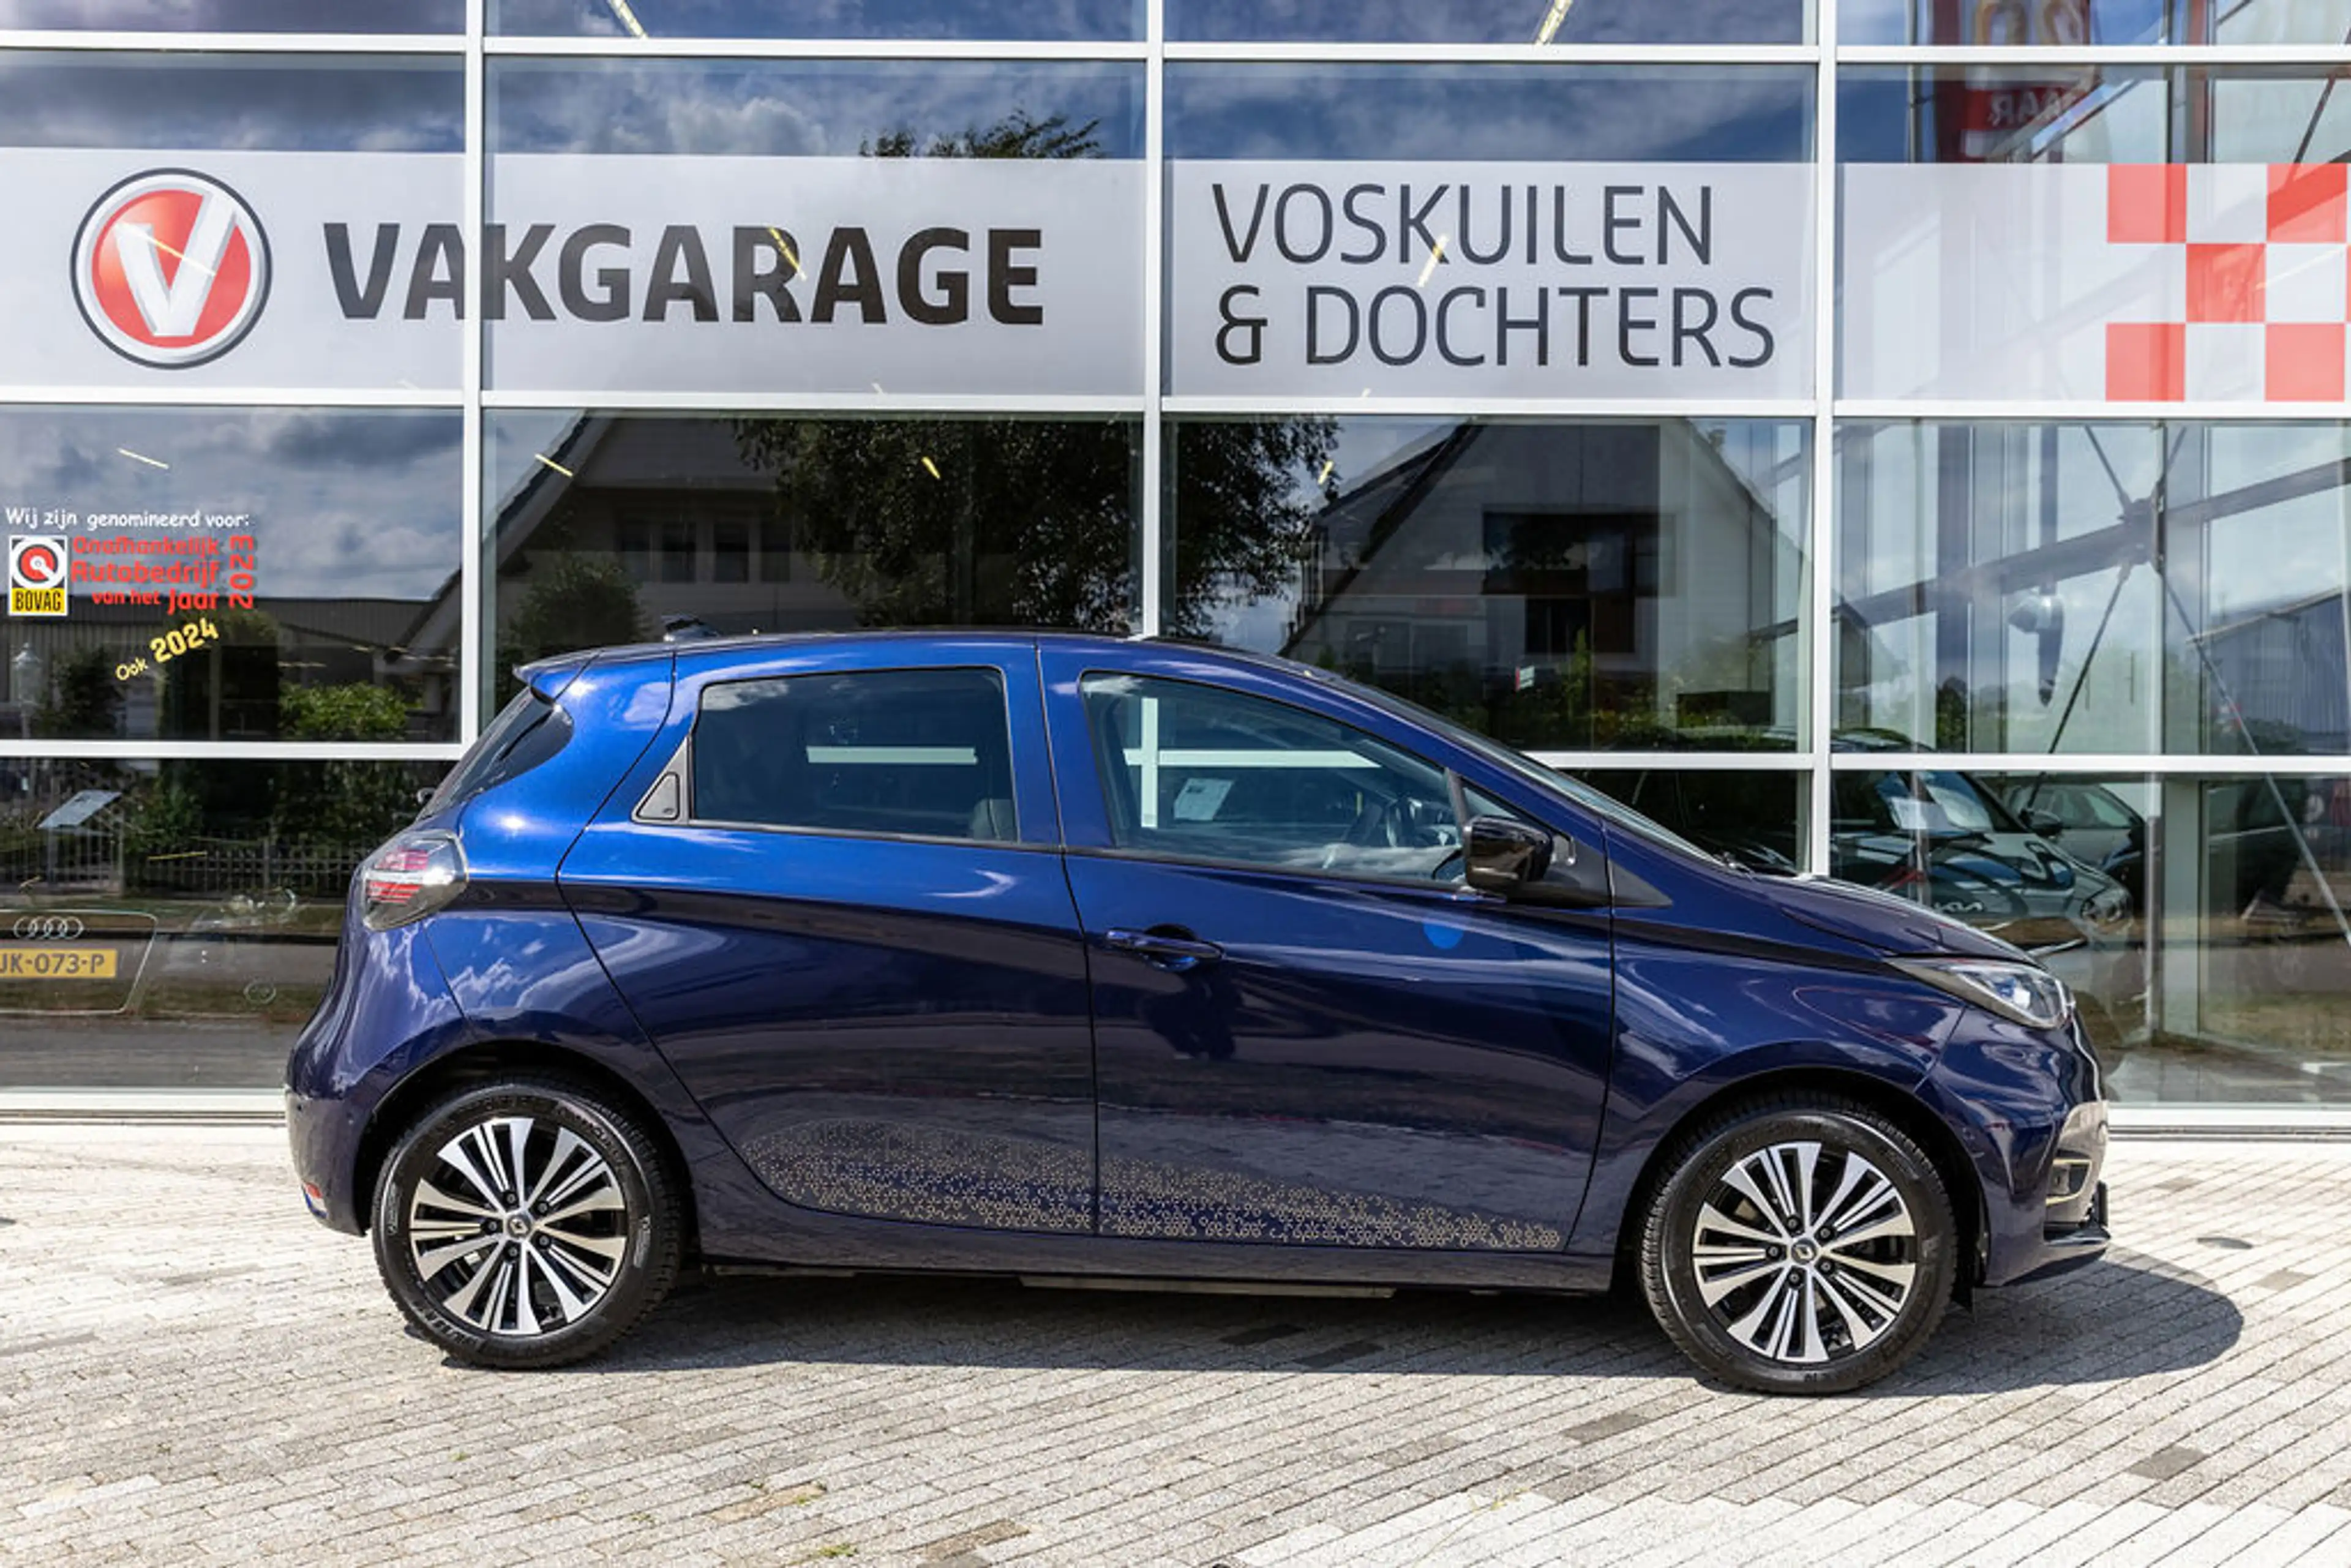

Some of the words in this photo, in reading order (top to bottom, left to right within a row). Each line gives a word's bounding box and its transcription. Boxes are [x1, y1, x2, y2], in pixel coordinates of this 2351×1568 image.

[1212, 184, 1712, 265] VOSKUILEN
[324, 223, 1043, 326] VAKGARAGE
[1215, 285, 1268, 366] &
[1306, 286, 1774, 368] DOCHTERS
[5, 507, 39, 529] Wij
[43, 510, 77, 530] zijn
[87, 509, 201, 531] genomineerd
[204, 513, 250, 528] voor:
[73, 535, 220, 559] Onafhankelijk
[70, 560, 220, 588] Autobedrijf
[229, 535, 254, 609] 2023
[15, 591, 61, 612] BOVAG
[92, 591, 126, 605] van
[130, 589, 160, 605] het
[115, 657, 148, 681] Ook
[149, 617, 219, 663] 2024
